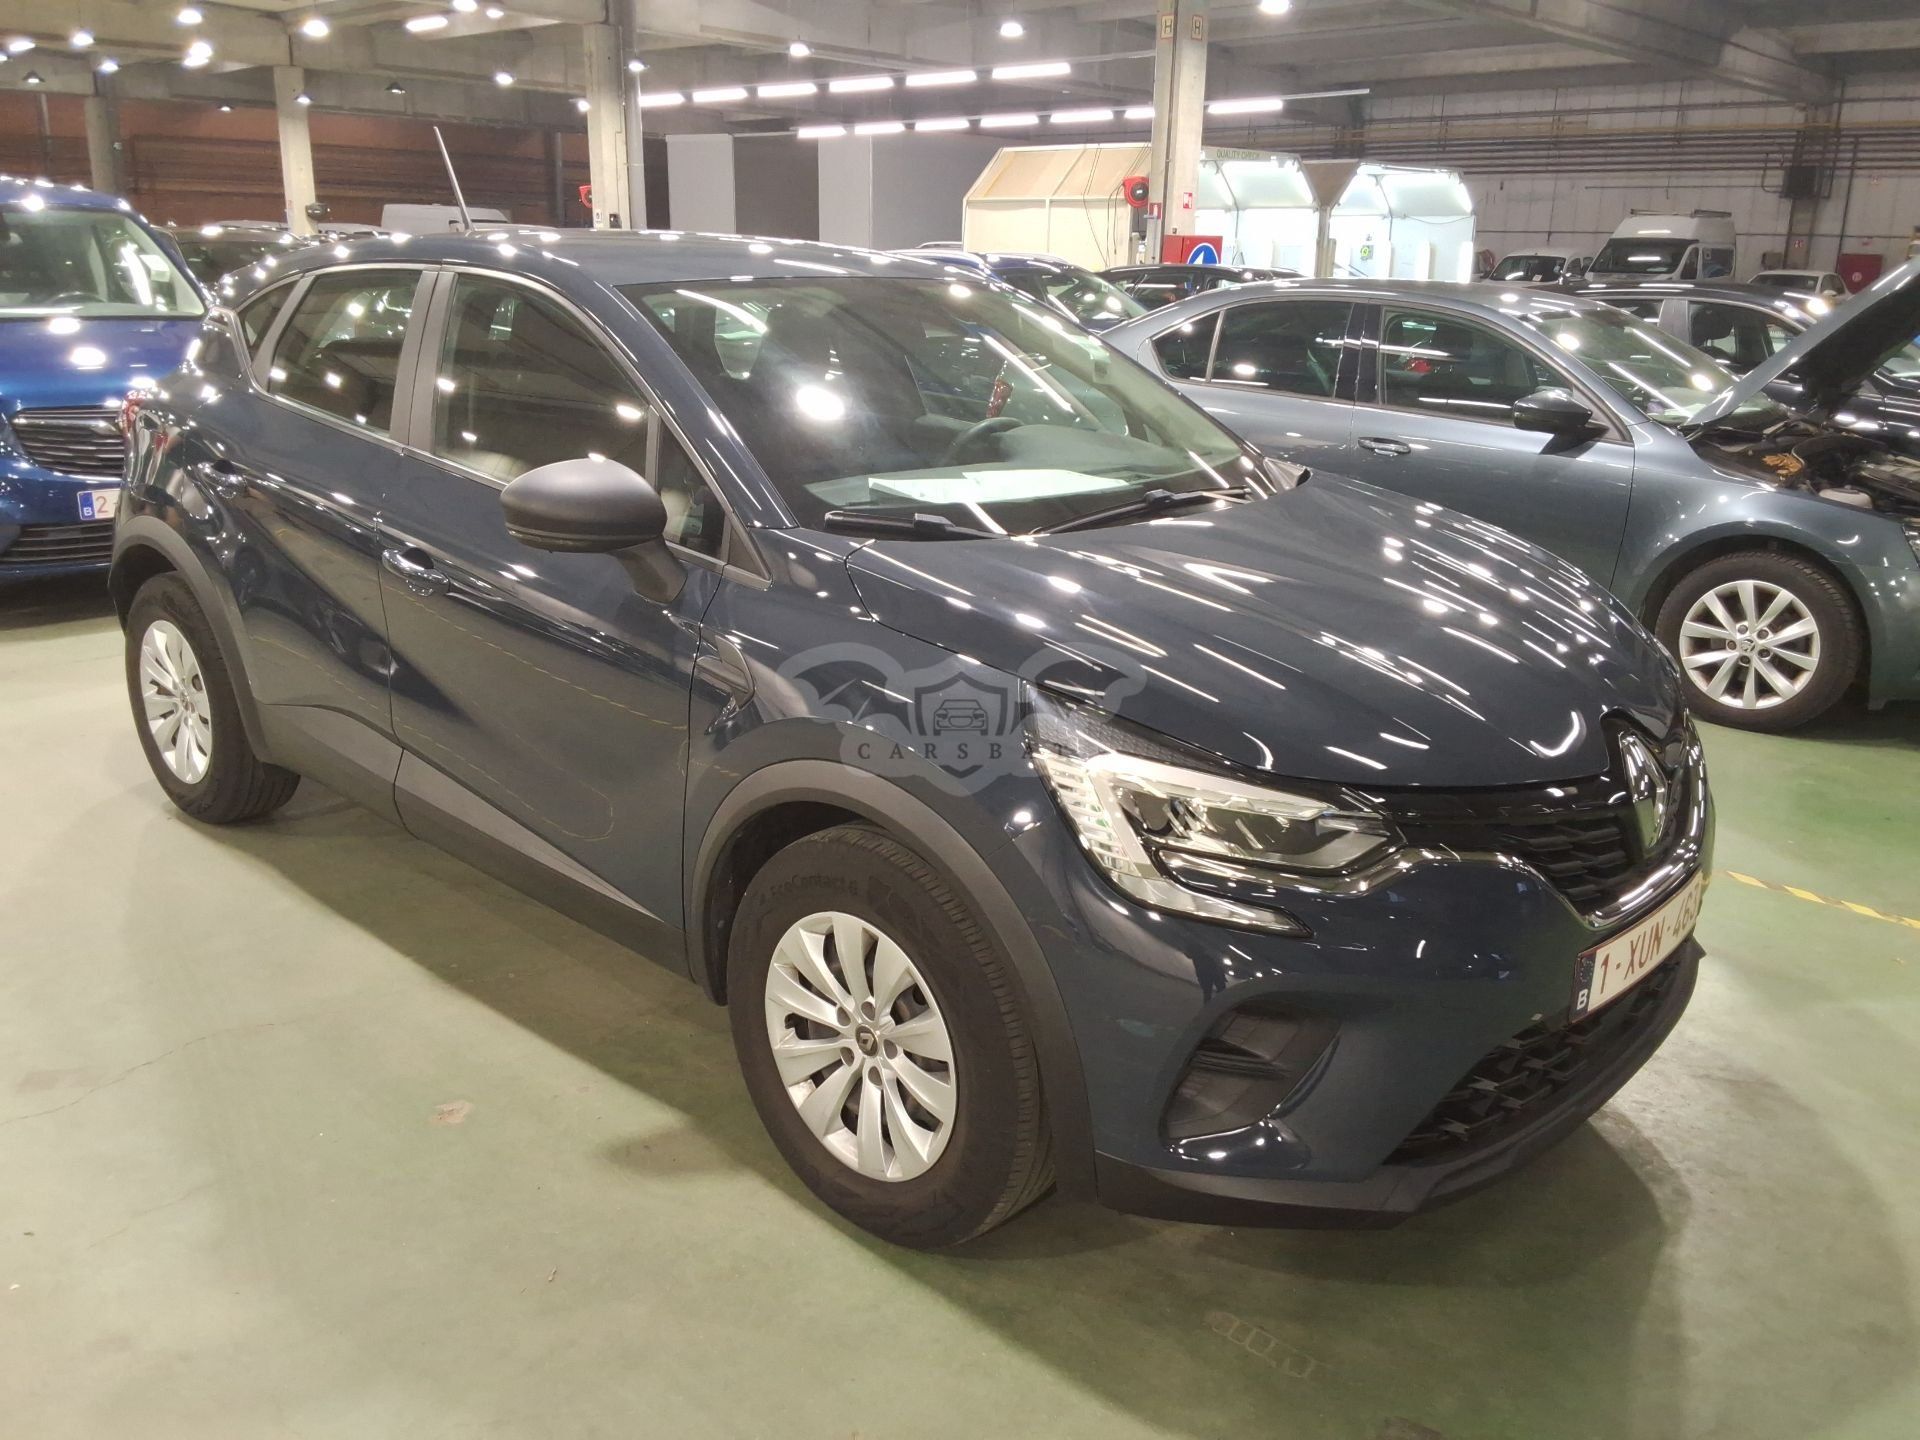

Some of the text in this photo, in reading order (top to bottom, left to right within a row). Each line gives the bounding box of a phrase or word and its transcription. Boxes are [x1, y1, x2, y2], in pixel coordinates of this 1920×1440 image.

[1164, 18, 1173, 34] H
[1194, 19, 1201, 35] H
[1216, 148, 1240, 159] QUALITY
[83, 507, 93, 517] B
[1576, 988, 1589, 1011] B
